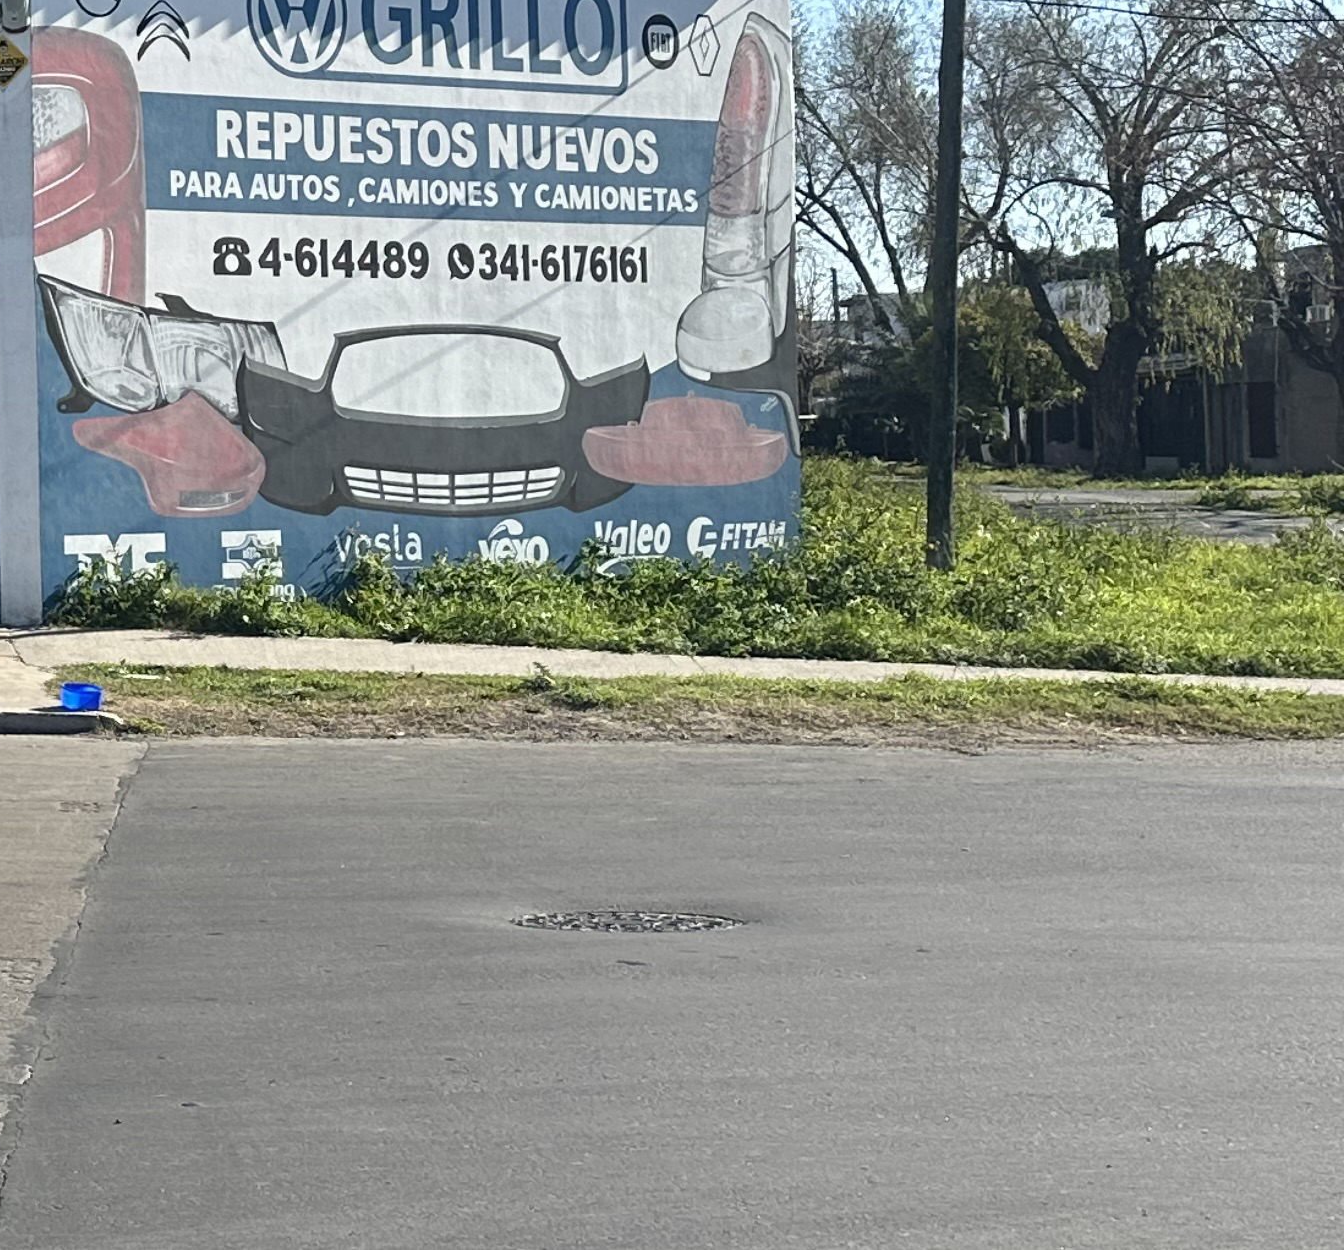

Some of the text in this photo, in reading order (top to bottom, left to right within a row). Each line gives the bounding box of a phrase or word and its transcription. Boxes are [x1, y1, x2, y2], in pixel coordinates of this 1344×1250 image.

[216, 109, 659, 175] REPUESTOS NUEVOS
[169, 170, 243, 198] PARA
[509, 183, 530, 208] Y
[534, 184, 699, 213] CAMIONETAS
